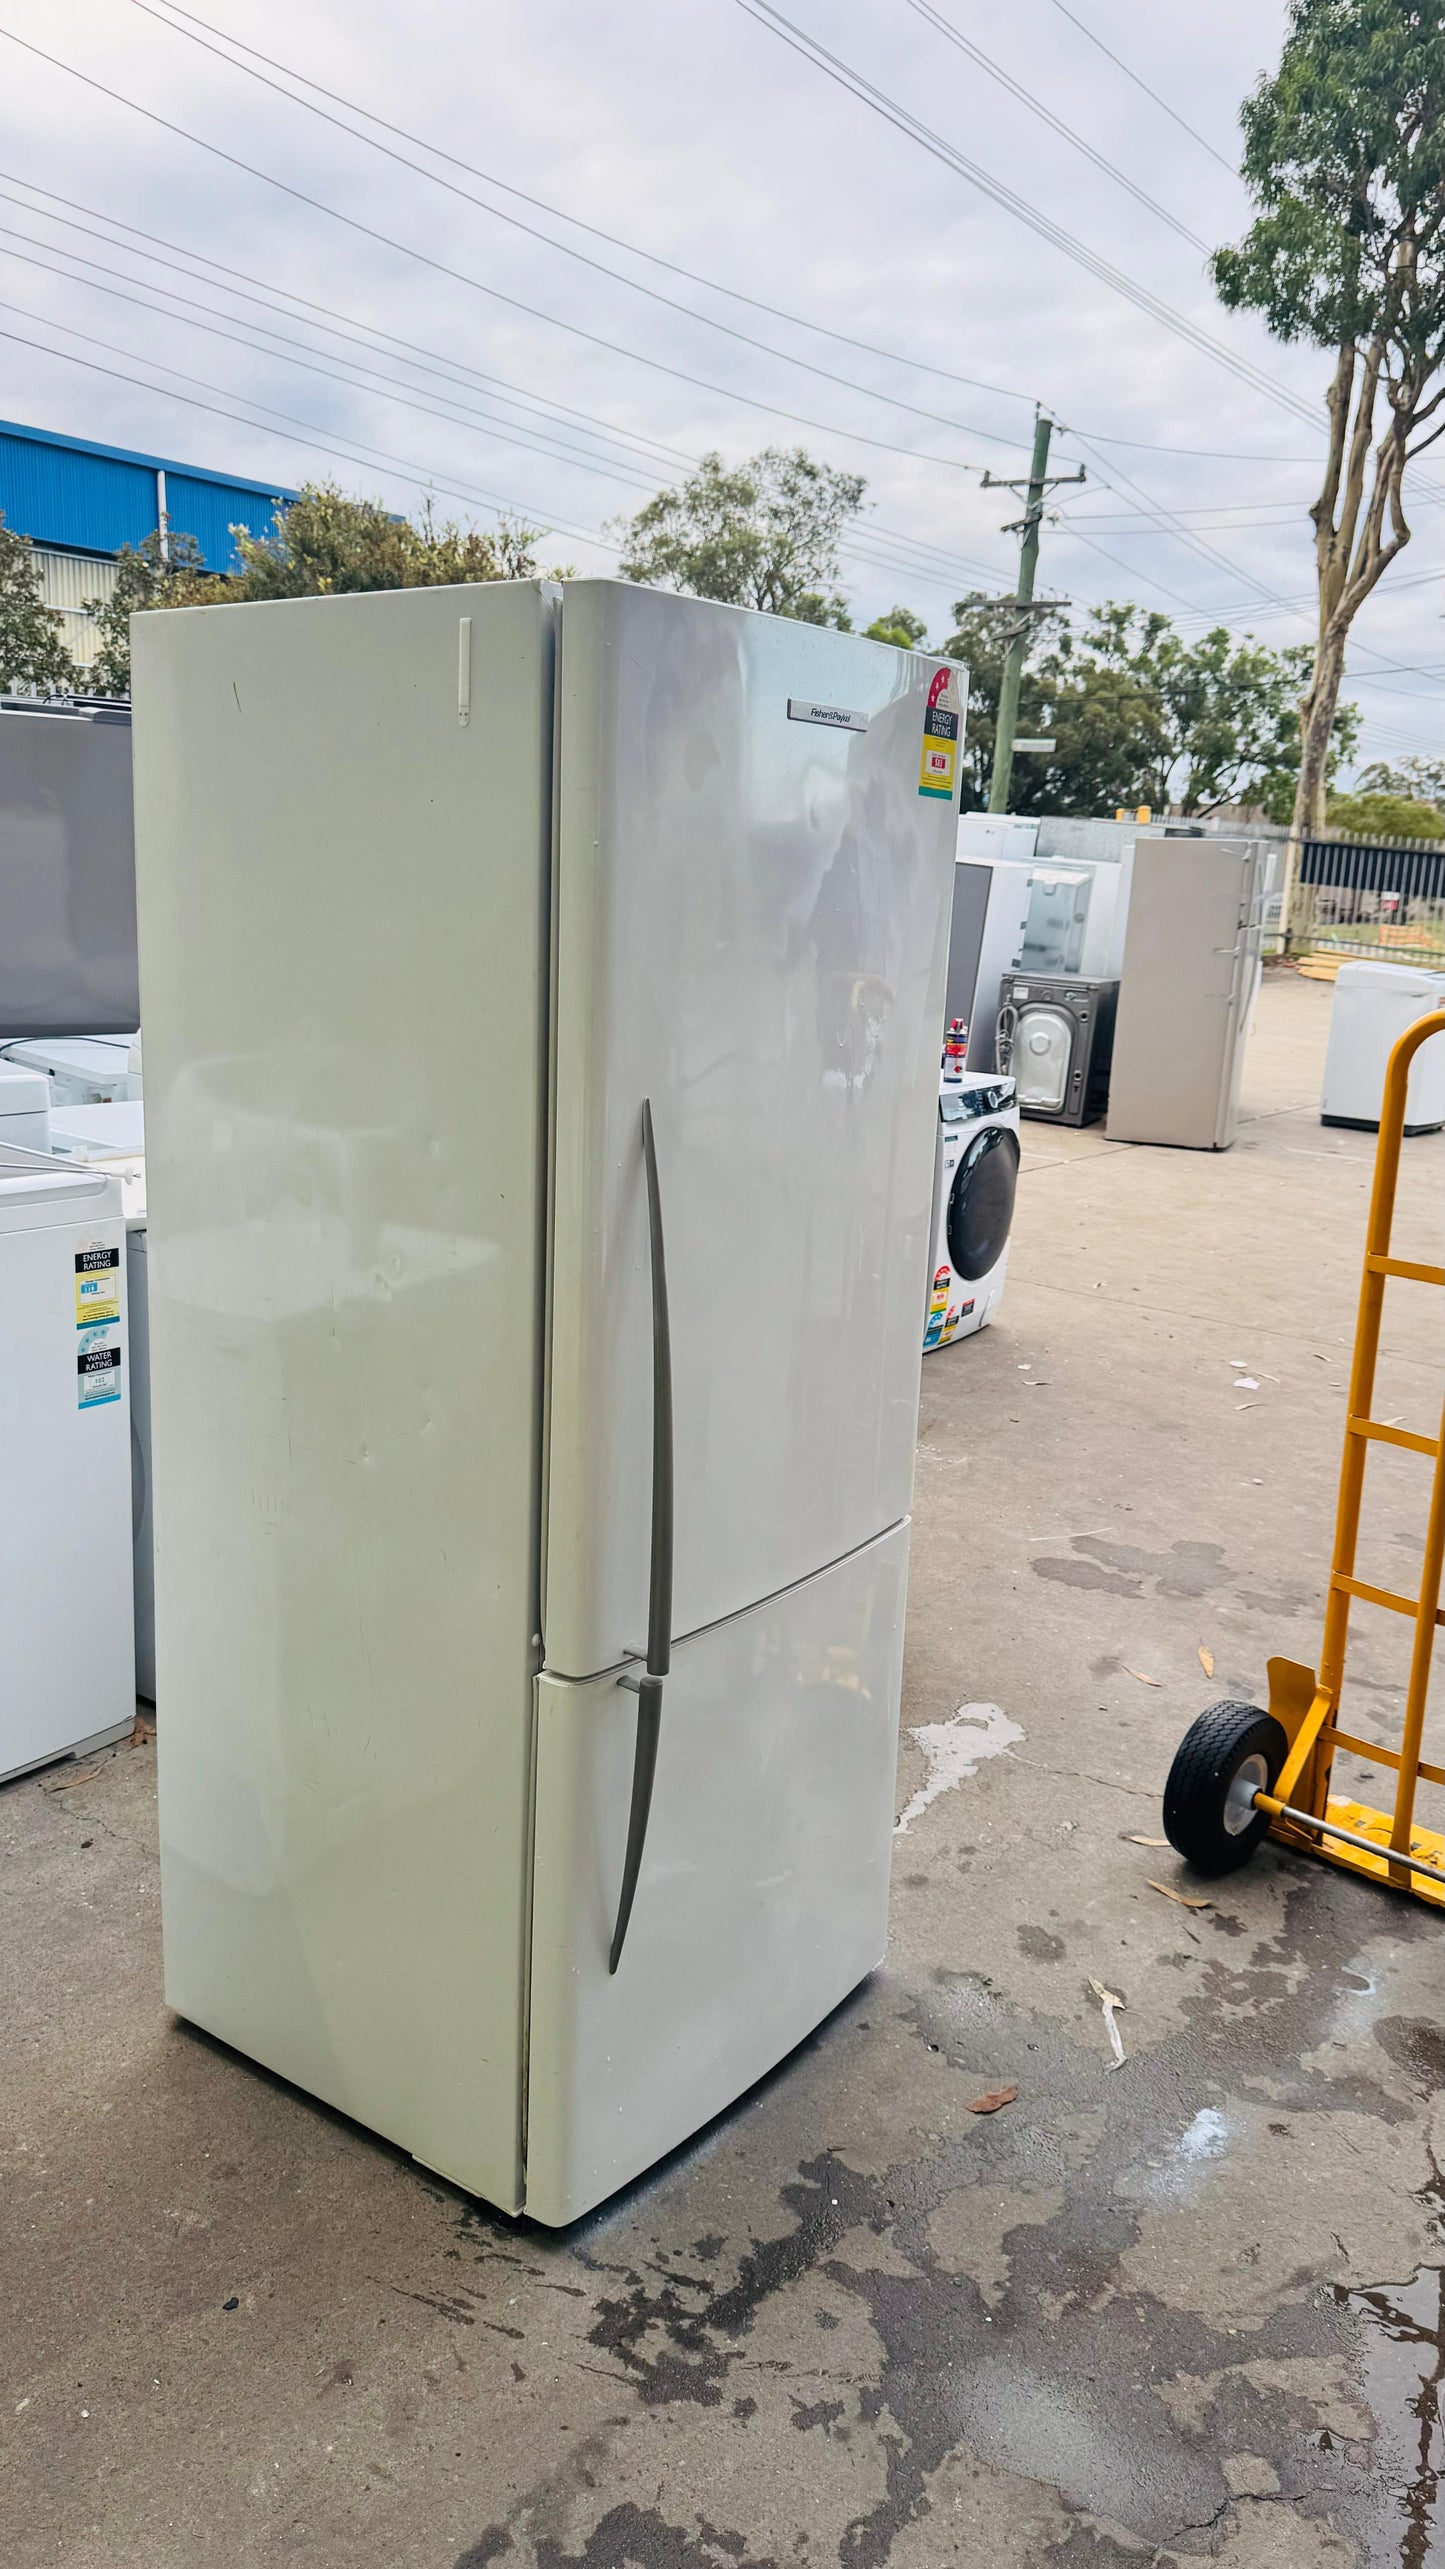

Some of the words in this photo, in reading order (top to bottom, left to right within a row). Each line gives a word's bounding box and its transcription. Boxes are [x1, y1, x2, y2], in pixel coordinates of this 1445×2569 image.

[932, 710, 953, 725] ENERGY
[932, 722, 951, 737] RATING
[83, 1251, 112, 1262] ENERGY
[83, 1260, 111, 1271] RATING
[87, 1351, 112, 1362] WATER
[85, 1359, 113, 1371] RATING
